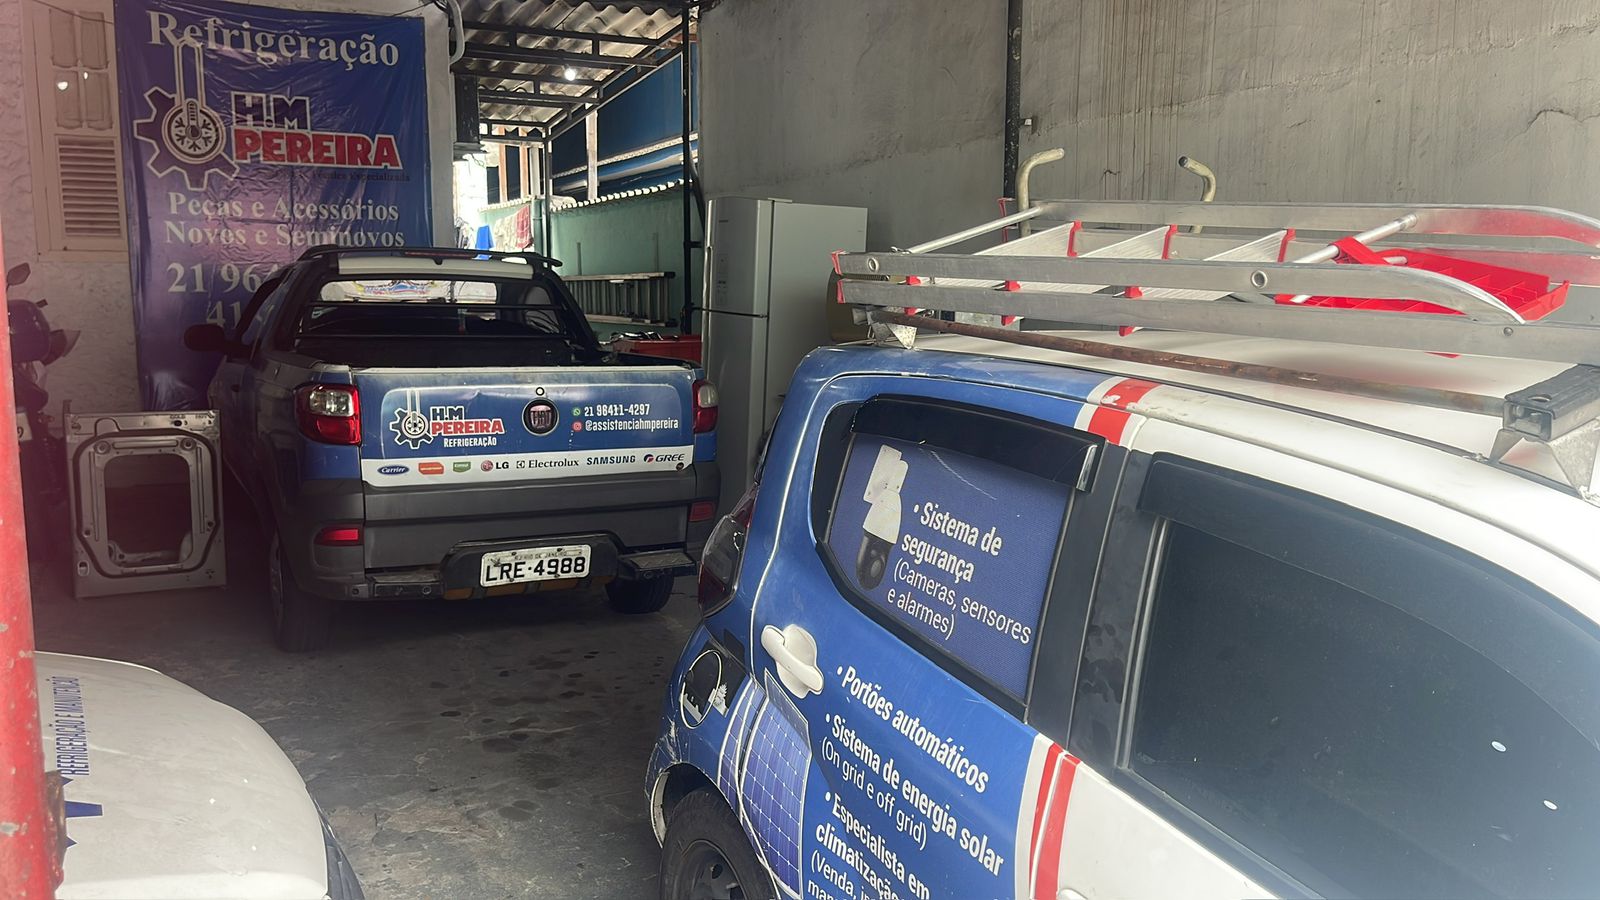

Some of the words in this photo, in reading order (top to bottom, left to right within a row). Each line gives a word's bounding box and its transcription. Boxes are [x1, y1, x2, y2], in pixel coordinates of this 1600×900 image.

[147, 10, 399, 70] Refrigeração
[232, 128, 402, 169] PEREIRA
[168, 192, 243, 220] Peças
[252, 199, 264, 218] e
[272, 197, 399, 221] Acessórios
[164, 221, 246, 245] Novos
[255, 229, 267, 245] e
[276, 223, 405, 248] Seminovos
[166, 262, 208, 293] 21
[584, 406, 594, 417] 21
[596, 404, 650, 417] 96411-4297
[585, 418, 679, 432] @assistenciahmpereira
[431, 419, 504, 435] PEREIRA
[443, 436, 497, 448] REFRIGERAÇÃO
[381, 466, 408, 474] Carrier
[496, 461, 509, 470] LG
[528, 459, 579, 469] Electrolux
[586, 455, 636, 466] SAMSUNG
[655, 453, 685, 463] GREE
[920, 501, 979, 547] Sistema
[980, 526, 1002, 556] de
[901, 533, 974, 583] segurança
[887, 588, 896, 603] e
[897, 592, 955, 640] alarmes)
[893, 557, 957, 610] (Cameras,
[961, 597, 1032, 644] sensores
[841, 666, 894, 721] Portões
[892, 709, 989, 794] automáticos
[821, 736, 841, 768] (On
[842, 759, 865, 791] grid
[867, 782, 874, 799] e
[876, 792, 896, 817] off
[896, 809, 928, 851] grid)
[832, 714, 880, 774] Sistema
[882, 757, 900, 790] de
[902, 779, 957, 840] energia
[959, 827, 1004, 877] solar
[832, 793, 905, 884] Especialista
[908, 873, 930, 900] em
[810, 850, 858, 900] (Venda,
